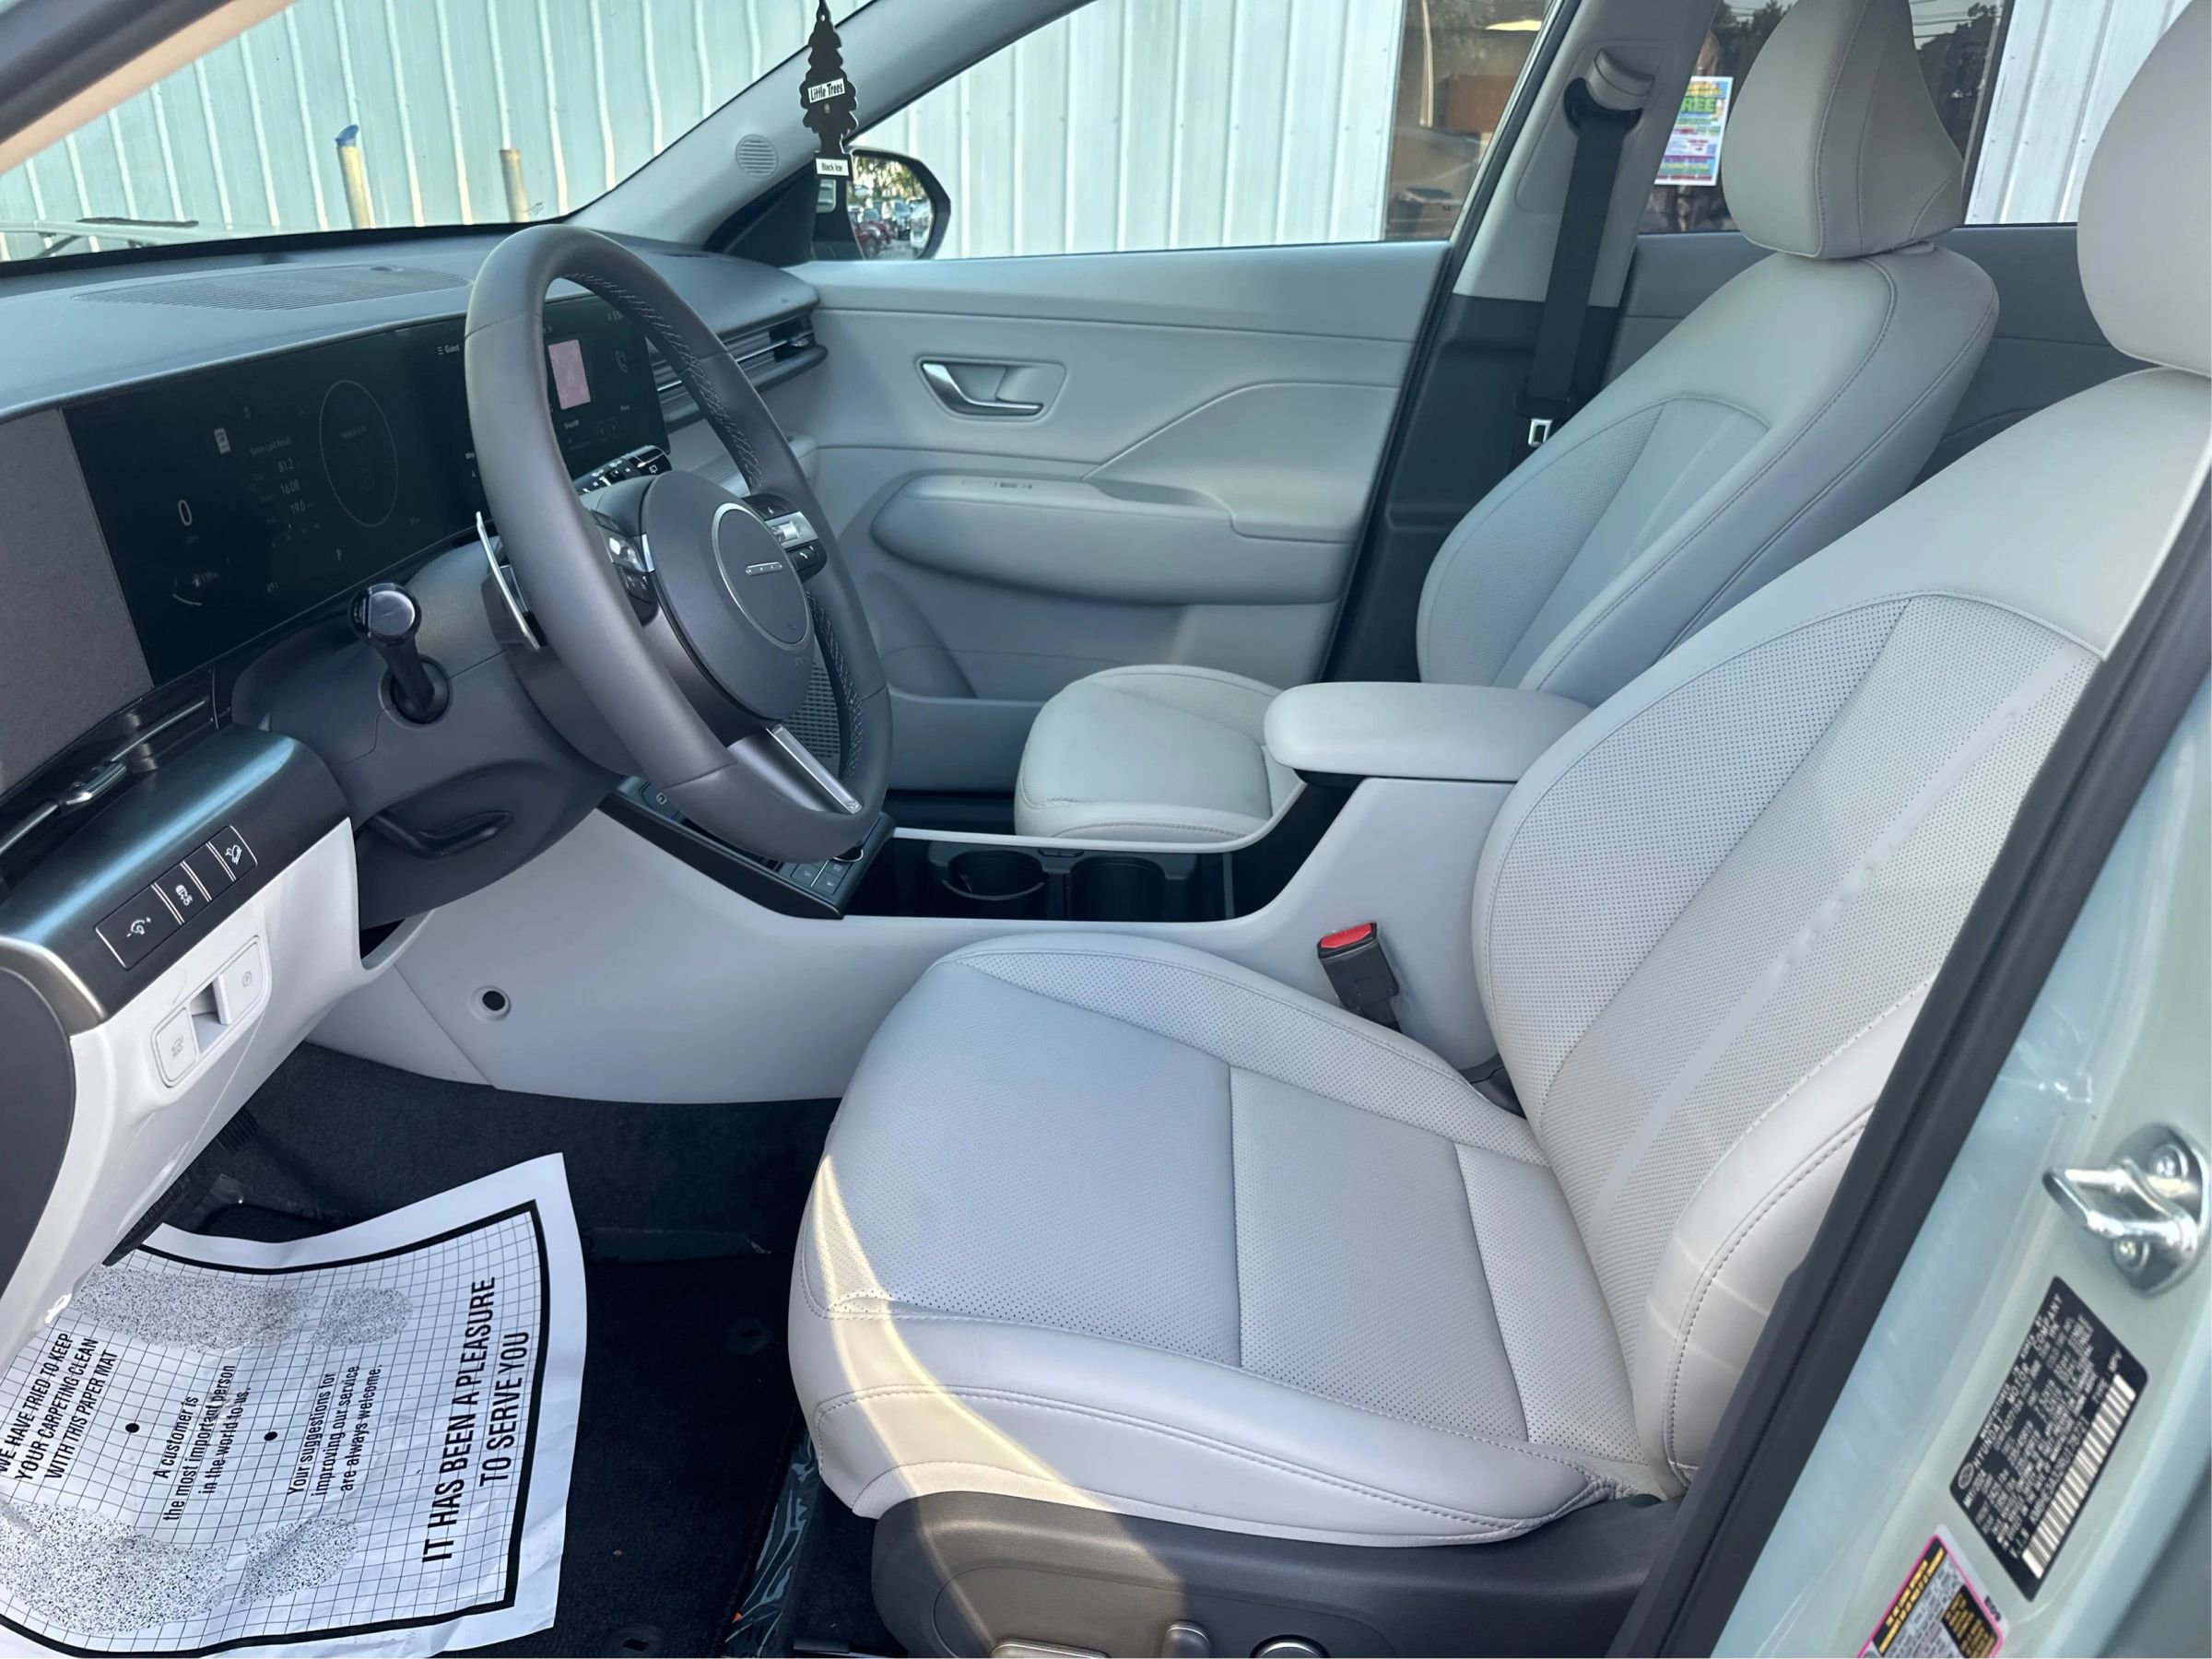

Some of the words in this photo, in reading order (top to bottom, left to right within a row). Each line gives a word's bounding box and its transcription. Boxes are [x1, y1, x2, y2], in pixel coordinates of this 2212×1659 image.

[811, 86, 826, 100] Little
[826, 82, 843, 99] Trees
[1680, 97, 1716, 112] REE
[821, 162, 834, 171] Black
[834, 163, 843, 171] Ice
[444, 344, 461, 354] Guest
[178, 499, 193, 525] 0
[48, 1333, 74, 1362] KEEP
[455, 1277, 495, 1388] PLEASURE
[499, 1331, 530, 1375] YOU
[40, 1362, 60, 1377] TO
[211, 1365, 236, 1402] person
[1972, 1414, 2004, 1470] HYUNDAI
[2006, 1360, 2030, 1406] MOTOR
[2032, 1291, 2063, 1354] COMPANY
[23, 1378, 52, 1411] TRIED
[181, 1396, 199, 1406] is
[234, 1386, 252, 1405] us.
[339, 1366, 359, 1406] service
[452, 1391, 480, 1406] A
[15, 1441, 49, 1479] YOUR
[38, 1376, 80, 1439] CARPETING
[68, 1337, 99, 1375] CLEAN
[45, 1443, 76, 1478] WITH
[63, 1416, 88, 1441] THIS
[76, 1378, 105, 1416] PAPER
[94, 1350, 118, 1377] MAT
[226, 1407, 243, 1419] to
[333, 1410, 348, 1429] our
[487, 1378, 523, 1452] SERVE
[5, 1411, 35, 1446] HAVE
[161, 1409, 194, 1466] customer
[184, 1405, 221, 1462] important
[216, 1422, 239, 1455] world
[287, 1466, 310, 1496] Your
[300, 1391, 331, 1463] suggestions
[318, 1373, 336, 1389] for
[345, 1422, 370, 1465] always
[440, 1413, 477, 1474] BEEN
[153, 1470, 171, 1479] A
[205, 1460, 226, 1478] the
[311, 1432, 346, 1496] improving
[479, 1456, 512, 1488] TO
[175, 1465, 198, 1496] most
[197, 1482, 218, 1494] in
[340, 1470, 357, 1491] are
[162, 1500, 185, 1521] the
[427, 1478, 465, 1529] HAS
[422, 1539, 454, 1562] IT
